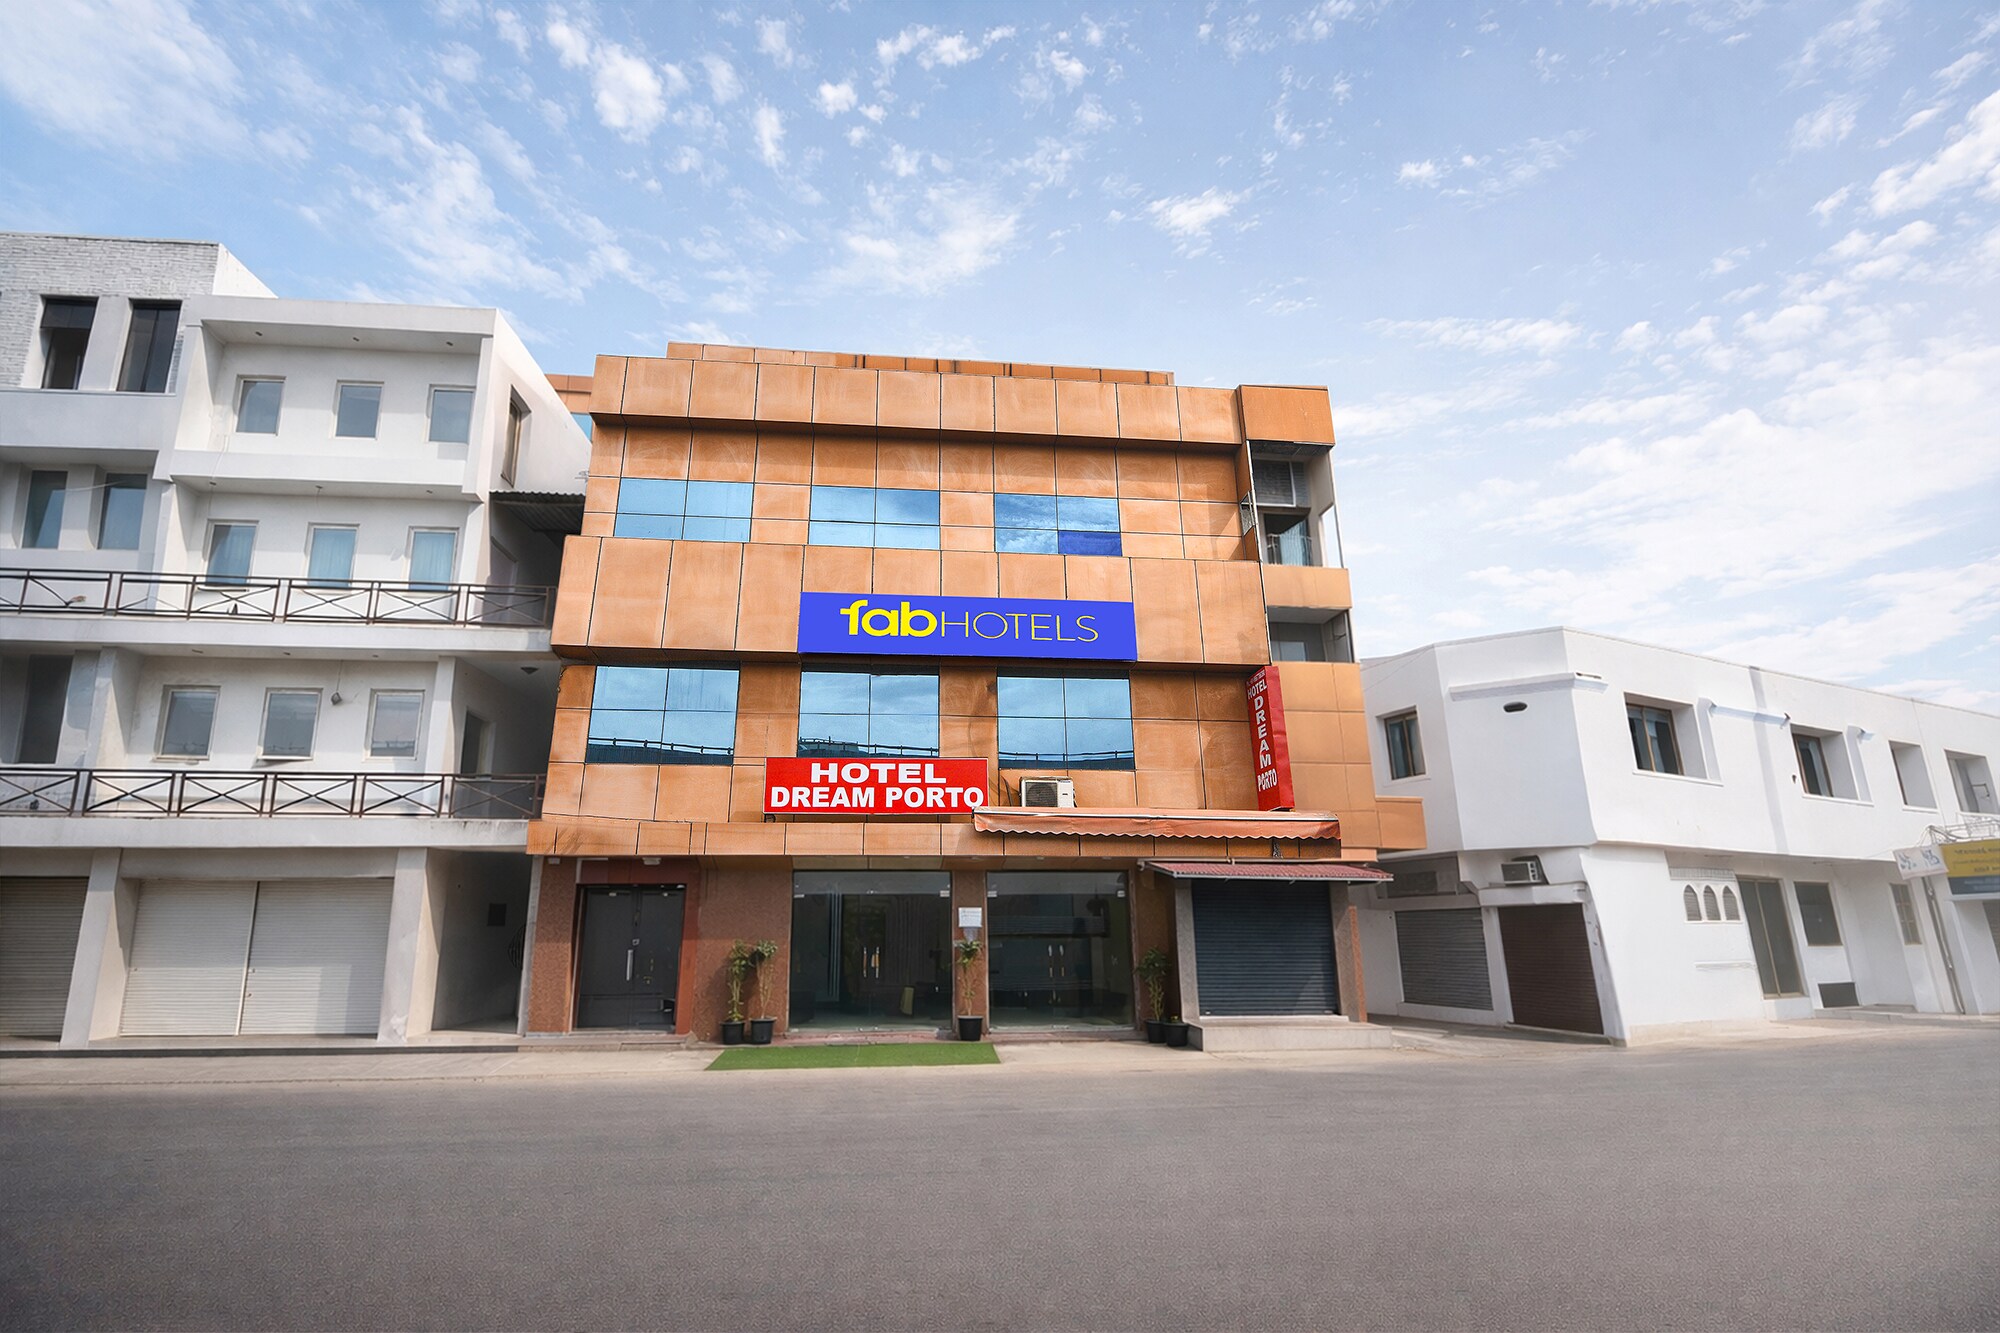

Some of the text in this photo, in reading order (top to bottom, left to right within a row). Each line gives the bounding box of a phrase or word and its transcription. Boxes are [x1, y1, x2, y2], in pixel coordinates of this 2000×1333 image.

[1247, 679, 1267, 699] HOTEL
[1254, 695, 1271, 768] DREAM
[810, 763, 947, 784] HOTEL
[1257, 768, 1277, 791] PORTO
[770, 786, 984, 808] DREAM PORTO
